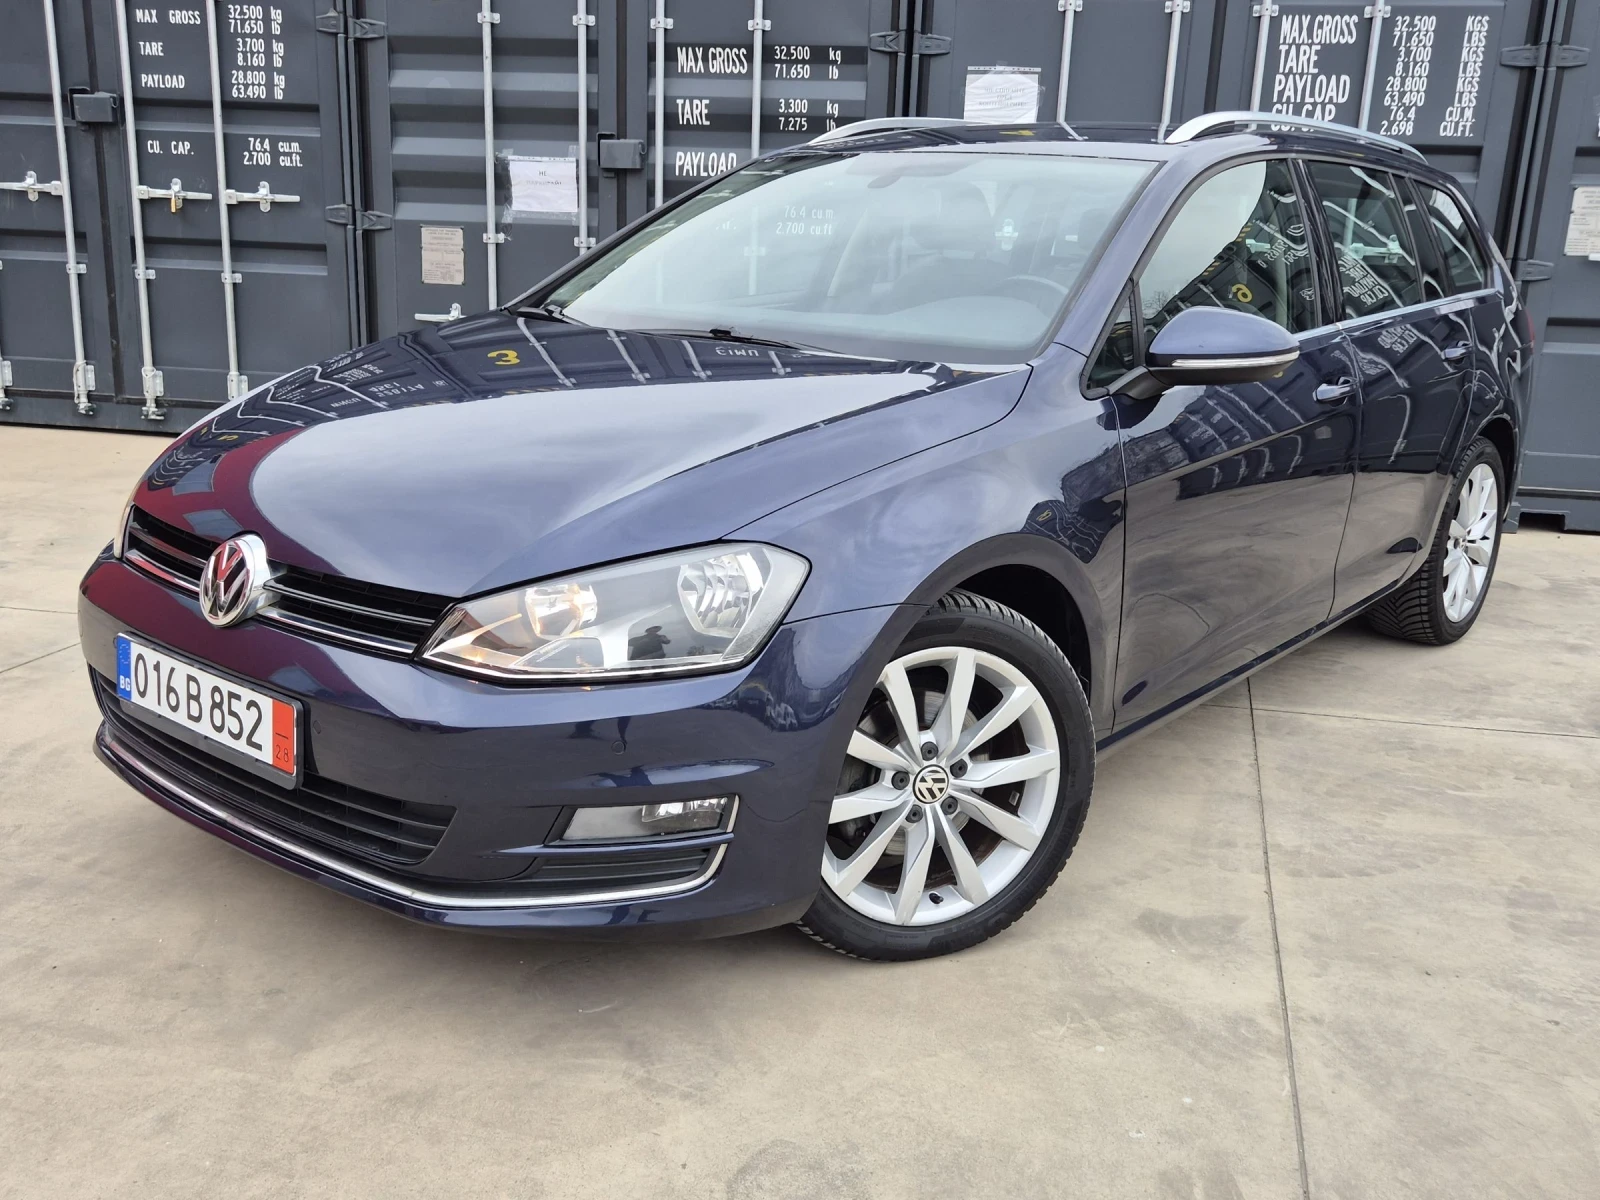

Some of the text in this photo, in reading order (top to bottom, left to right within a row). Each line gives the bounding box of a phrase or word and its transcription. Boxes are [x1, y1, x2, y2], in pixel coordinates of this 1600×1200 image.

[135, 8, 201, 25] MAX GROSS
[270, 5, 283, 23] kg
[271, 20, 281, 35] lb
[1465, 15, 1490, 32] KGS
[272, 39, 284, 56] kg
[1463, 31, 1488, 47] LBS
[138, 41, 164, 56] TARE
[829, 46, 842, 65] kg
[1460, 46, 1485, 63] KGS
[273, 53, 283, 68] lb
[676, 46, 748, 74] MAX GROSS
[1278, 44, 1322, 74] TARE
[828, 64, 839, 80] lb
[1458, 61, 1483, 77] LBS
[141, 73, 186, 89] PAYLOAD
[273, 71, 285, 89] kg
[1455, 76, 1481, 93] KGS
[274, 85, 284, 100] lb
[1272, 74, 1351, 104] PAYLOAD
[1453, 91, 1478, 107] LBS
[676, 98, 711, 126] TARE
[826, 99, 839, 118] kg
[1389, 106, 1416, 121] 76.4
[147, 140, 194, 155] CU. CAP.
[248, 137, 270, 152] 76.4
[675, 151, 737, 177] PAYLOAD
[487, 349, 521, 365] 3
[120, 675, 131, 692] BG
[275, 744, 290, 763] 28
